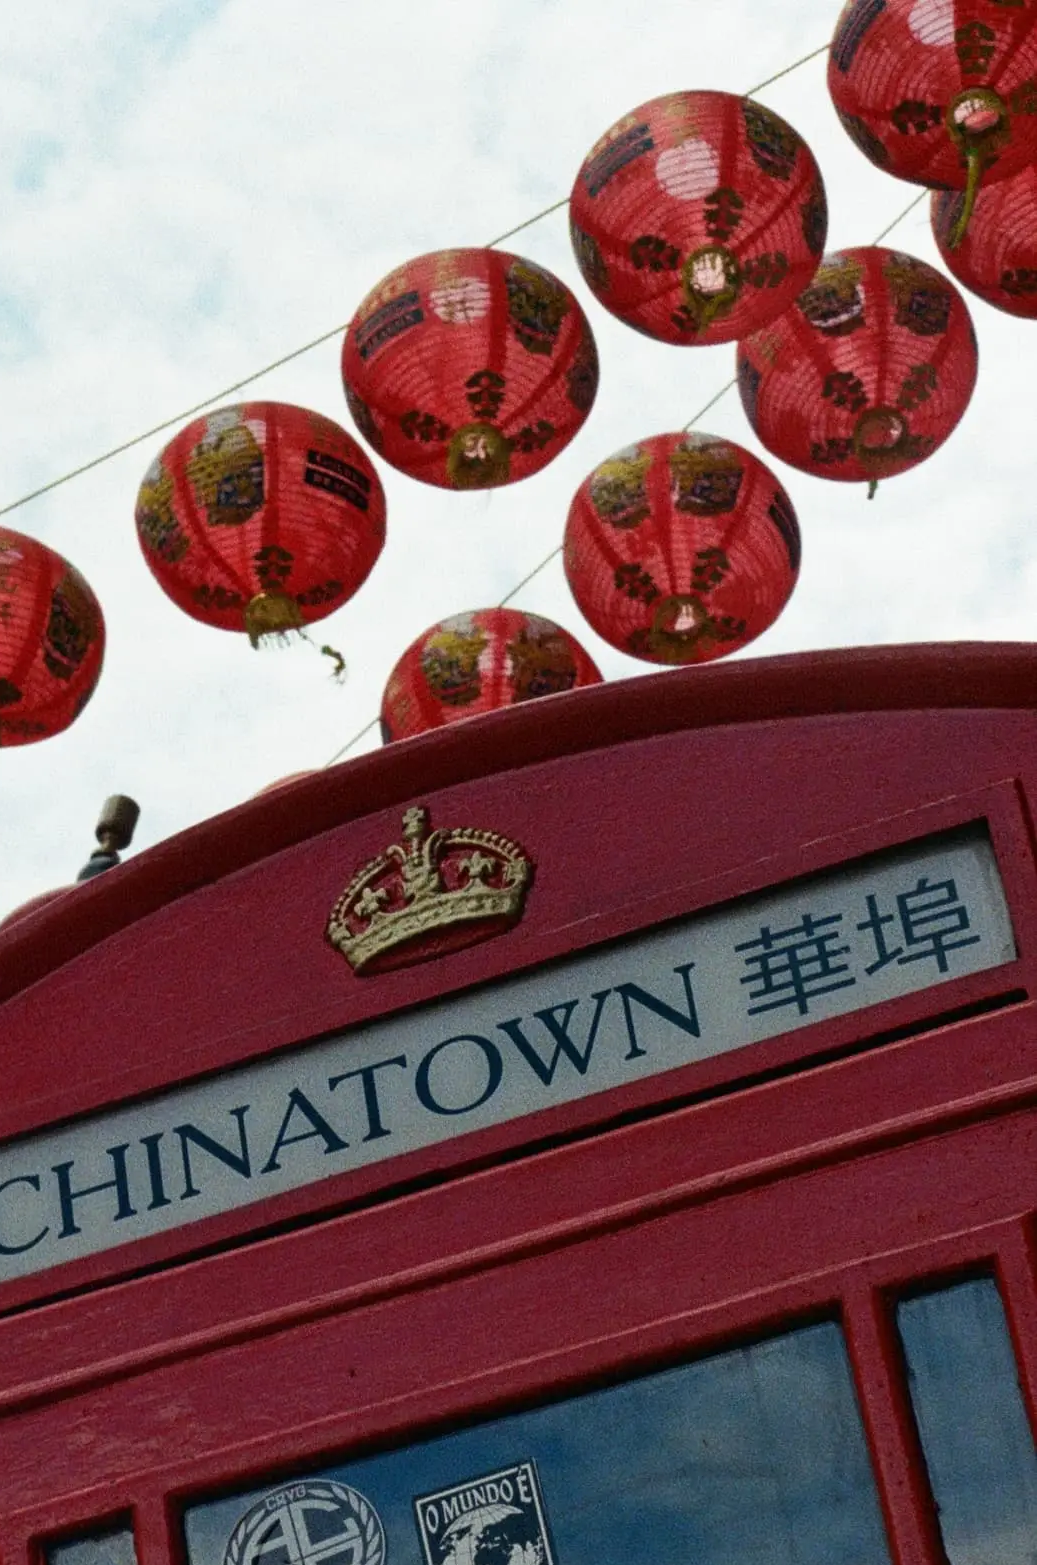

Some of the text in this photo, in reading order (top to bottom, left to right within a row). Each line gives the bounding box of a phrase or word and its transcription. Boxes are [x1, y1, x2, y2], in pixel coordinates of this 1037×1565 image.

[733, 876, 980, 1017] 華埠
[426, 1504, 439, 1534] O
[441, 1478, 514, 1524] MUNDO
